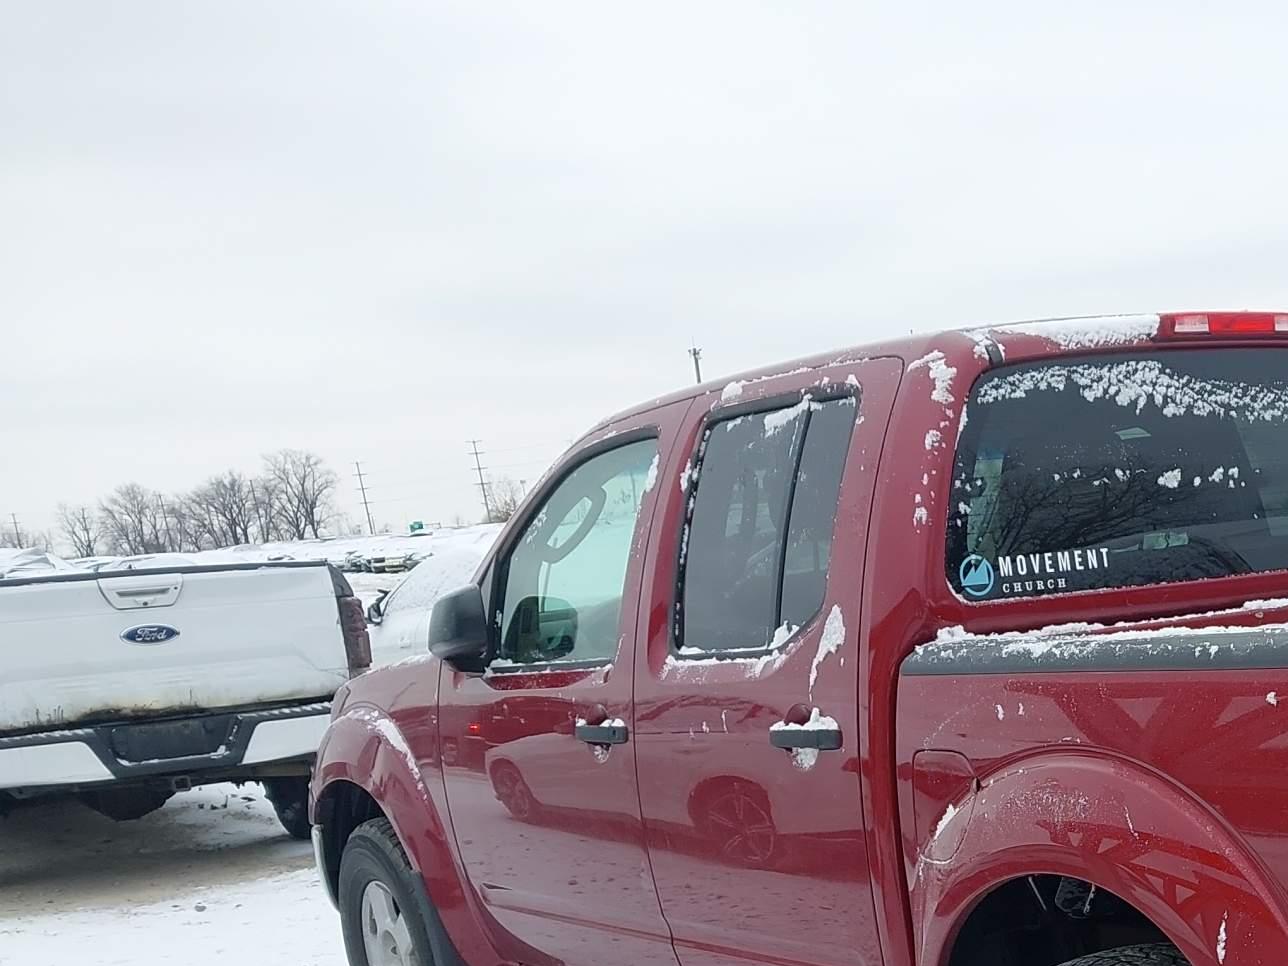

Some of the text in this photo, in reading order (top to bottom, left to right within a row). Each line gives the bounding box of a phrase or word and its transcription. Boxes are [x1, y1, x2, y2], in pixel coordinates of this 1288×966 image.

[998, 547, 1109, 577] MOVEMENT
[1002, 578, 1067, 593] CHURCH
[135, 627, 167, 641] Ford
